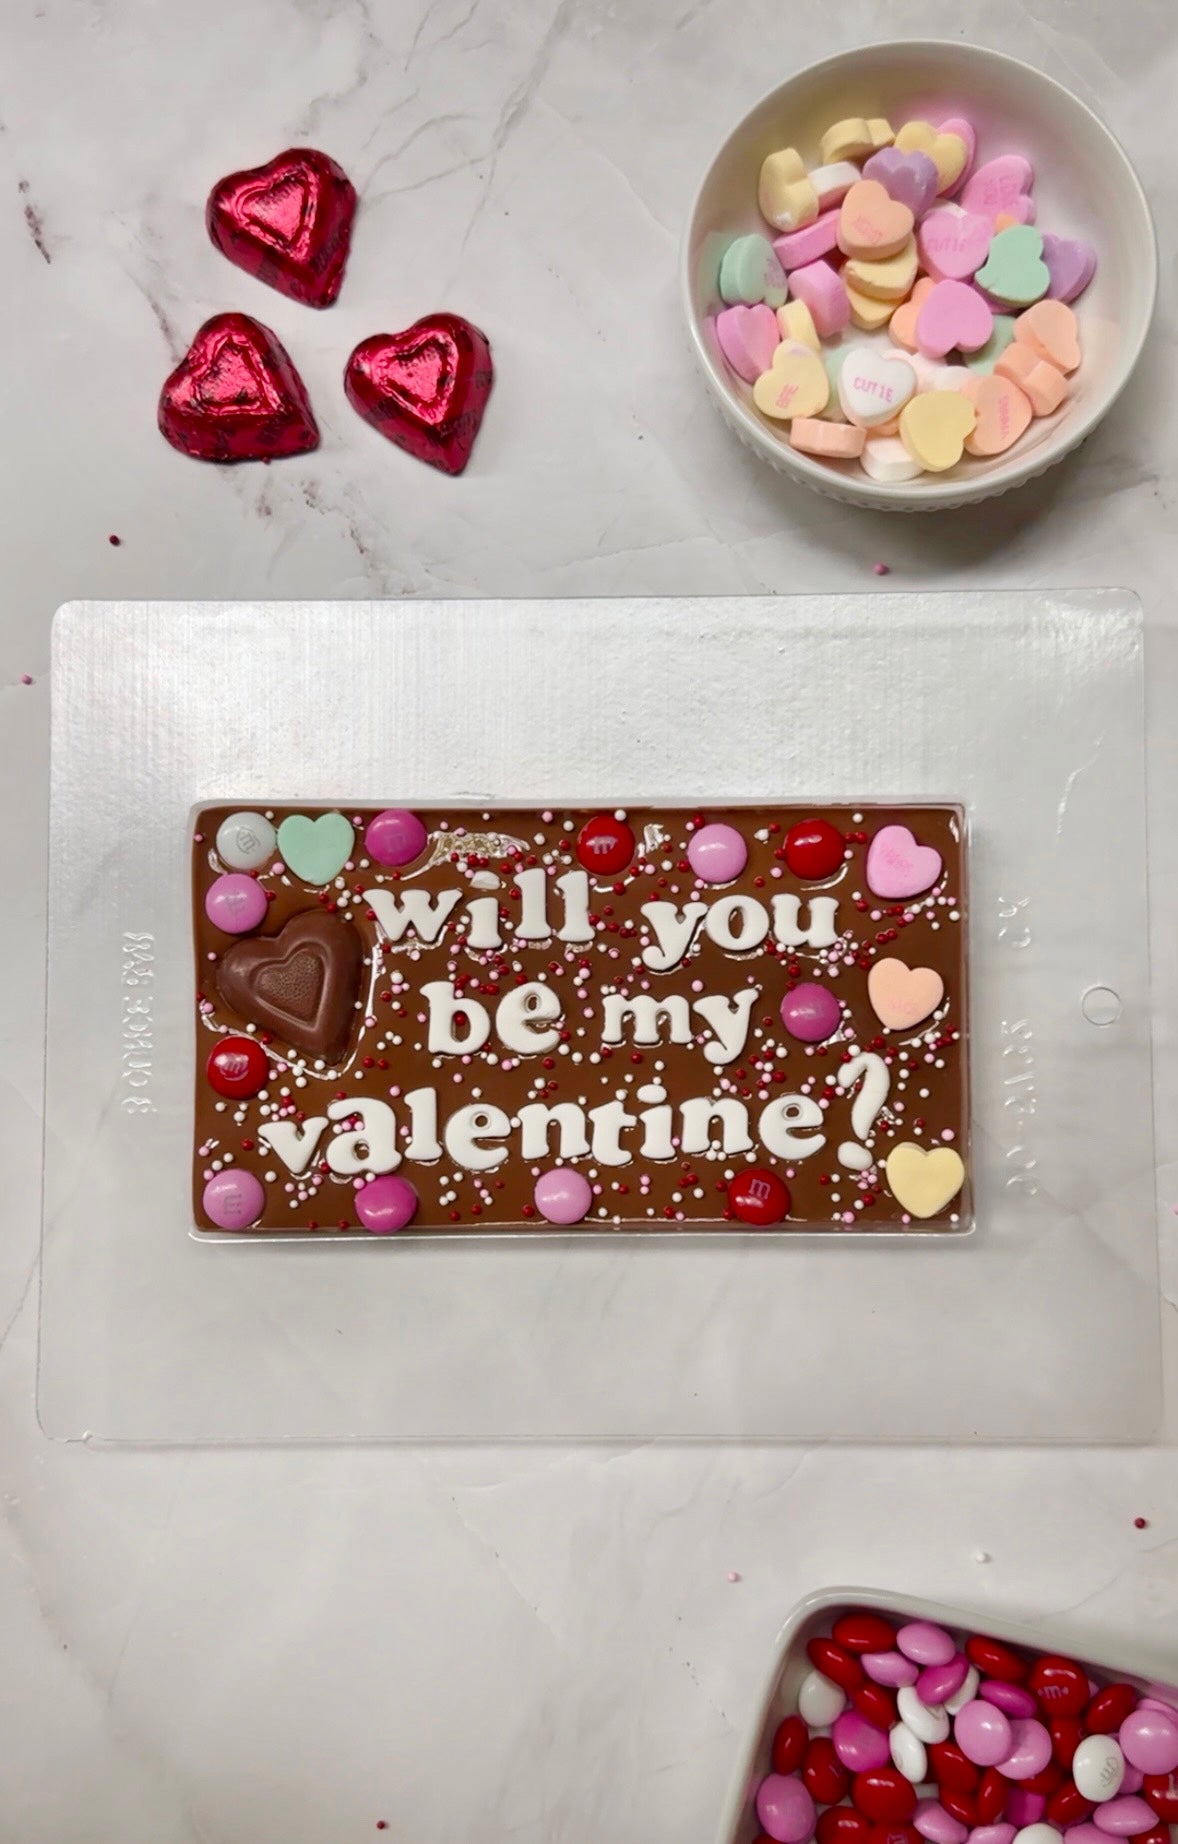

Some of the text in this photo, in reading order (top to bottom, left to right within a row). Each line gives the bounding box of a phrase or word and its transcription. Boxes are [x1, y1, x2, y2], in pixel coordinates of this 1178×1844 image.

[853, 376, 894, 403] CUTIE
[362, 868, 840, 971] will you
[420, 981, 763, 1065] be my
[258, 1051, 891, 1176] valentine?
